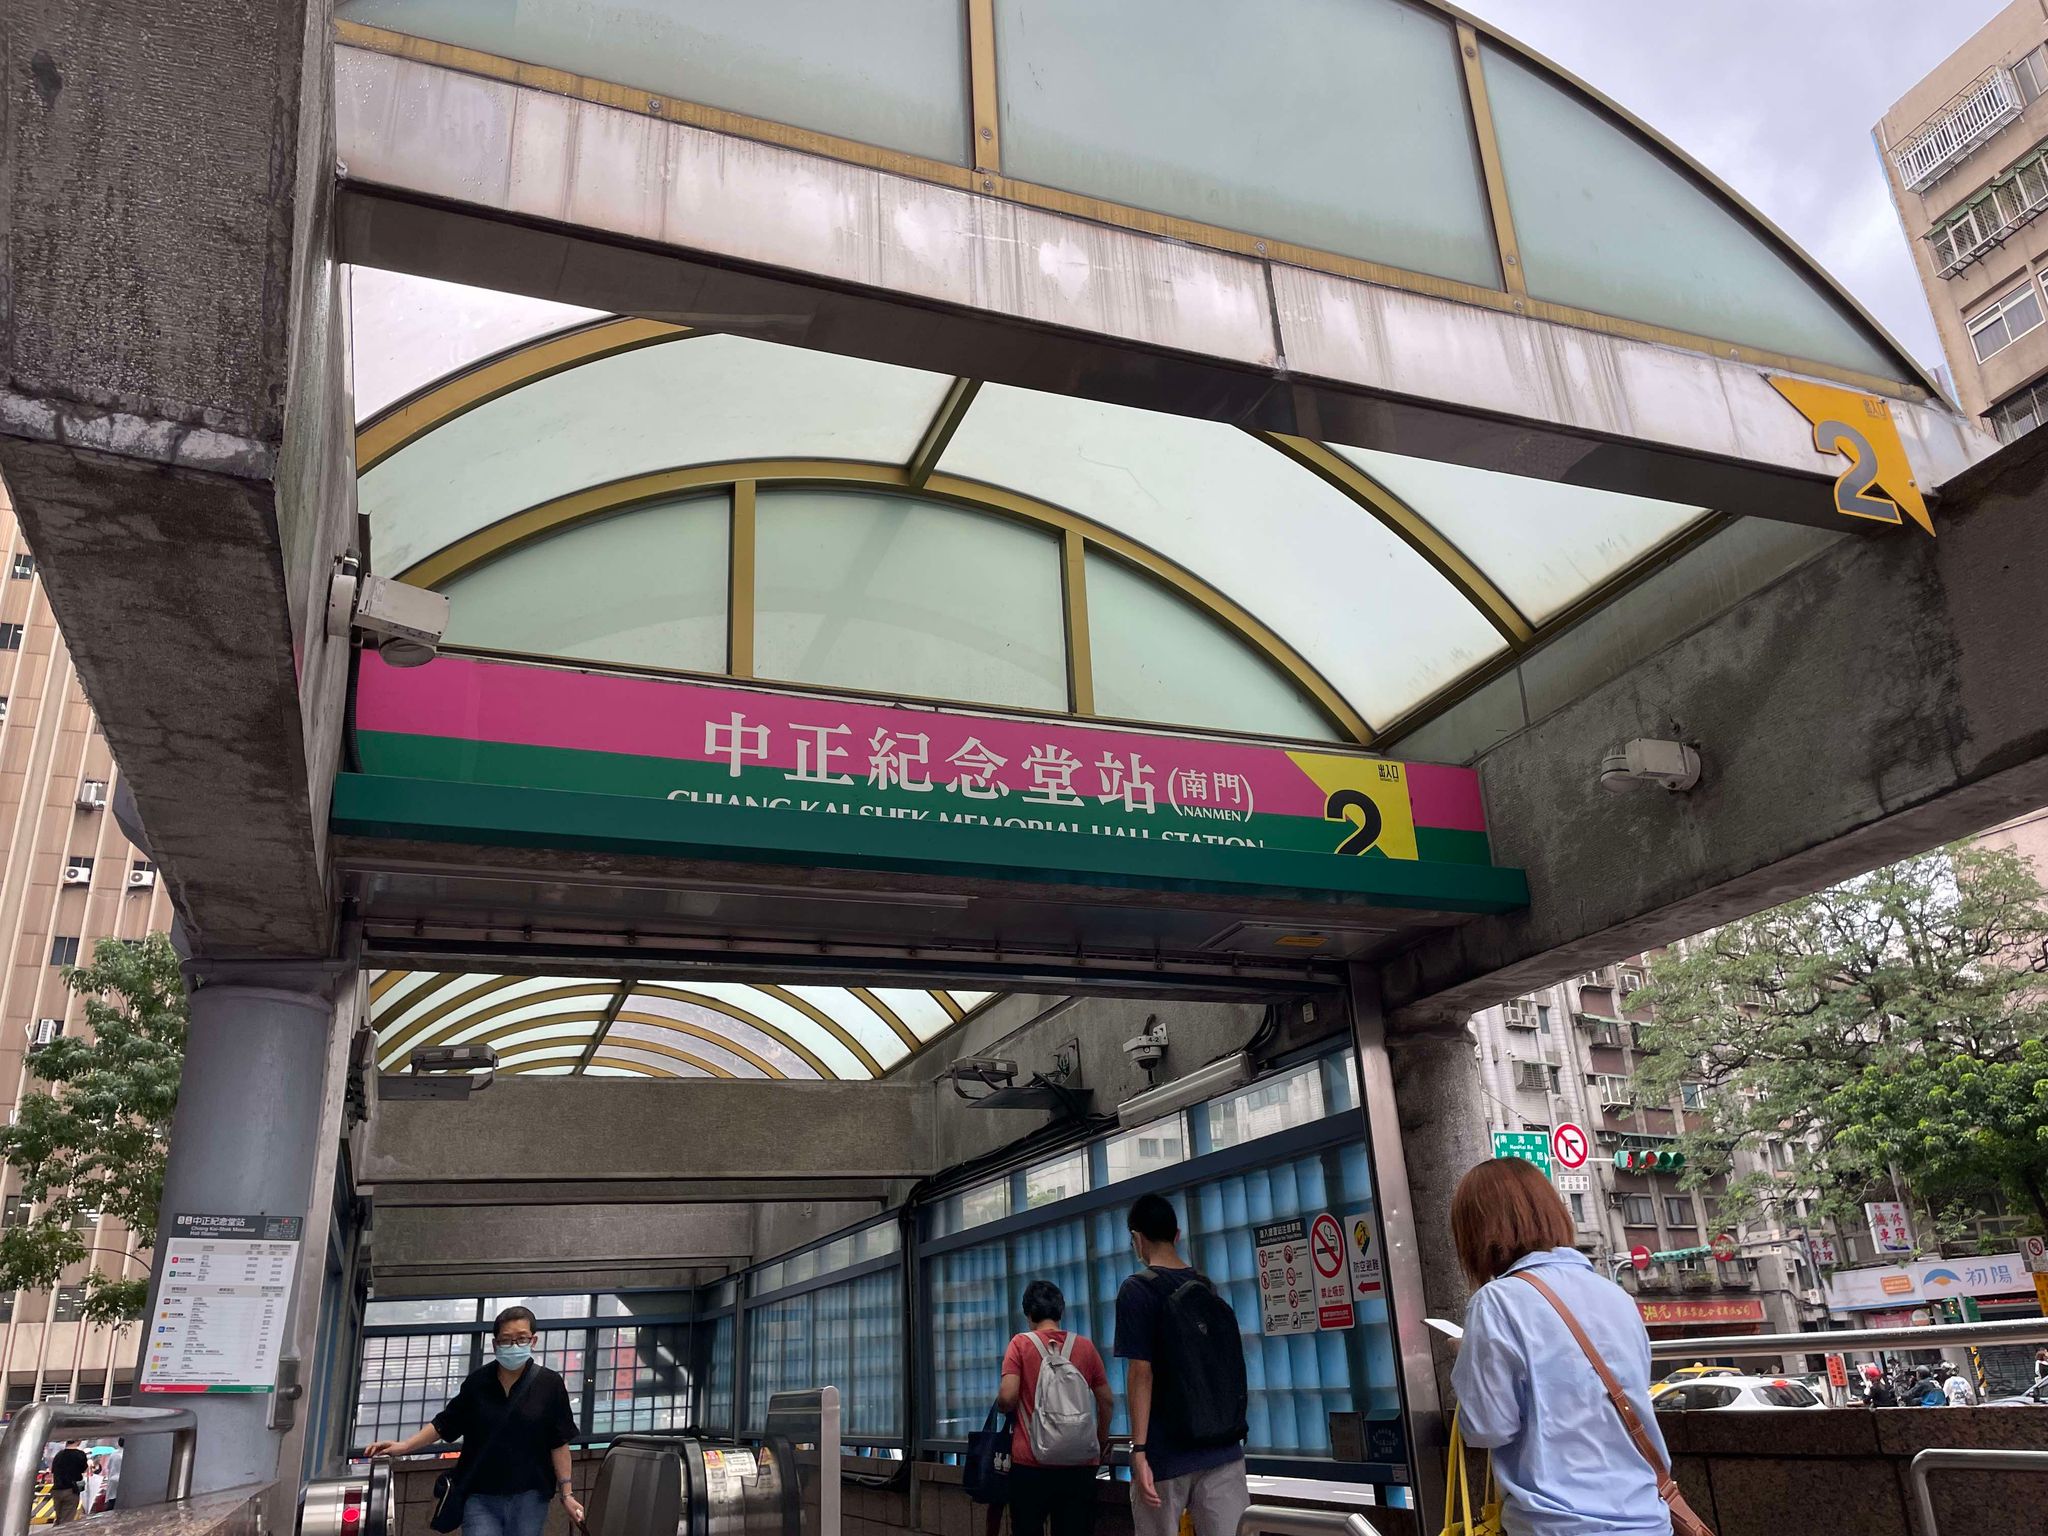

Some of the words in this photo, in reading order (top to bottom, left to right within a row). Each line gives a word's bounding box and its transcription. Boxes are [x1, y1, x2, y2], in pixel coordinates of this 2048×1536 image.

[1817, 420, 1898, 520] 2
[704, 712, 1156, 814] 中正紀念堂站
[1378, 764, 1399, 779] 出入口
[1184, 806, 1241, 821] NANMEN
[1326, 789, 1382, 856] 2
[193, 1216, 246, 1227] 中正紀念堂站
[1965, 1264, 2012, 1286] 初陽
